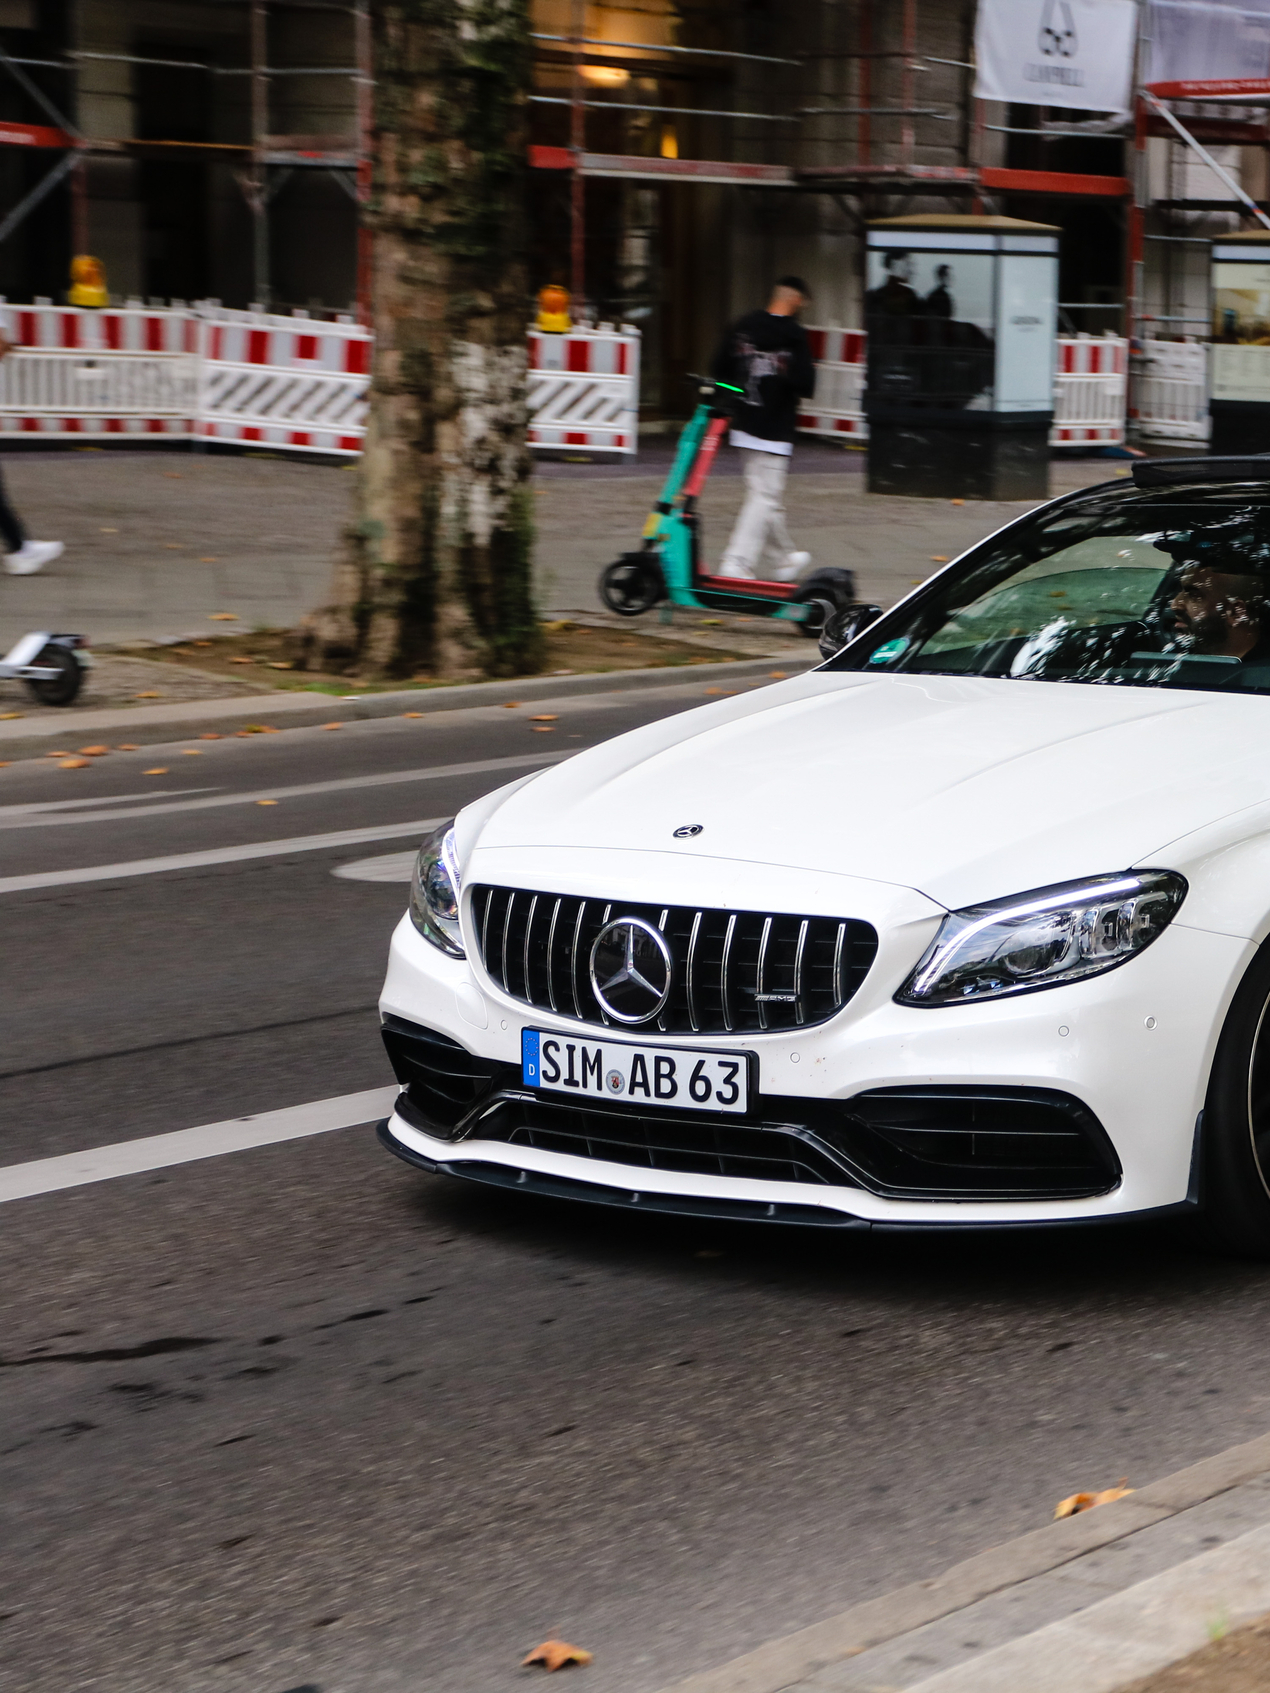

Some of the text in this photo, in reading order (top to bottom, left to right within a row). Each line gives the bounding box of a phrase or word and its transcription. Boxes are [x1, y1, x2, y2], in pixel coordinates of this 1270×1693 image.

[528, 1063, 536, 1077] D
[541, 1040, 739, 1105] SIM AB 63
